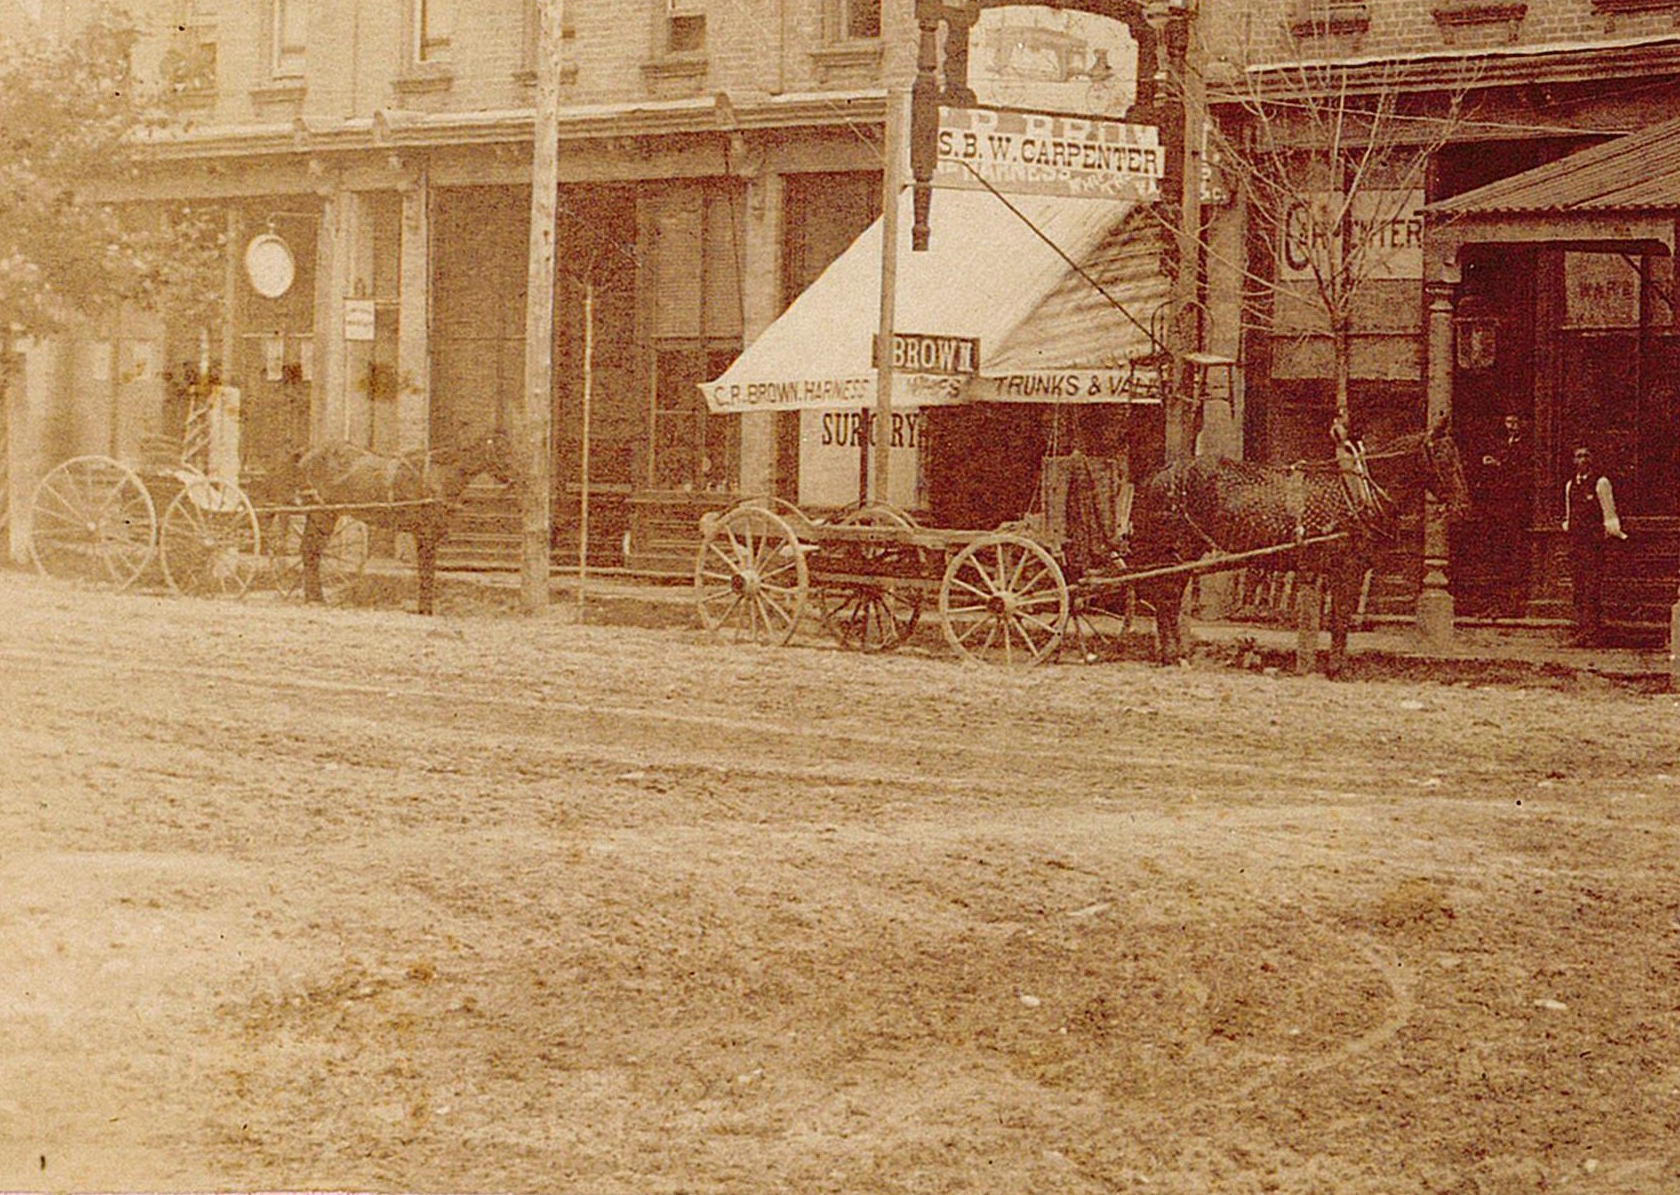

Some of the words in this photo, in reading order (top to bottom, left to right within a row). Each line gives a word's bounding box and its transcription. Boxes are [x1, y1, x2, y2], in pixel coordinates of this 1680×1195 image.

[1020, 138, 1159, 175] CARPENTER
[892, 338, 974, 373] BROWN
[993, 374, 1081, 397] TRUNKS
[1088, 376, 1102, 397] &
[822, 412, 919, 447] SURRY
